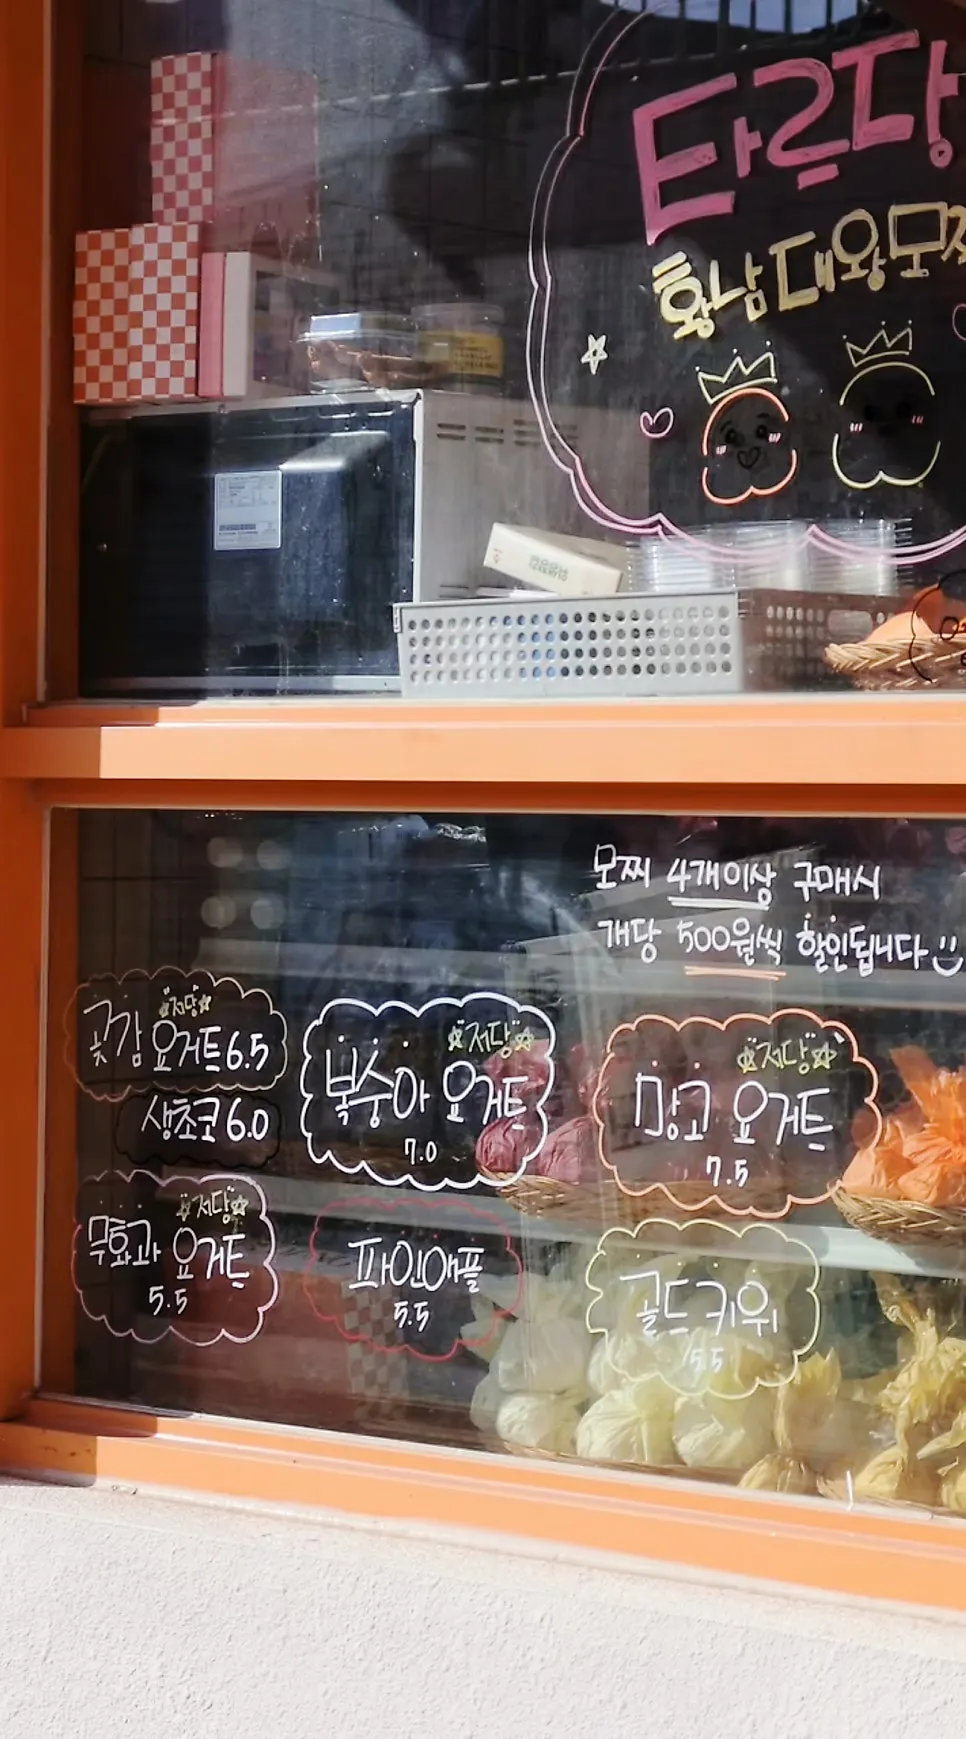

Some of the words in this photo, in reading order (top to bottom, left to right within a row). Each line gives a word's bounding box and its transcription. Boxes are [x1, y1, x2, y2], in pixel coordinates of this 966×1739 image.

[632, 29, 960, 246] 타르당
[593, 843, 652, 891] 모찌
[793, 860, 881, 901] 구매시
[597, 918, 663, 964] 개당
[676, 916, 784, 967] 500원씩
[796, 914, 930, 979] 할인됩니다
[168, 994, 199, 1018] 저당
[151, 1019, 222, 1073] 요거트
[226, 1030, 270, 1072] 6.5
[464, 1019, 515, 1060] 저당
[756, 1037, 812, 1076] 저당
[325, 1046, 432, 1129] 복숭아
[442, 1060, 529, 1132] 요거트
[634, 1072, 712, 1142] 망고
[732, 1080, 835, 1152] 요거트
[141, 1094, 221, 1144] 생초코
[226, 1096, 270, 1143] 6.0
[404, 1137, 438, 1166] 7.0
[705, 1155, 750, 1188] 7.5
[191, 1190, 234, 1225] 저당
[88, 1215, 163, 1268] 무화과
[172, 1226, 251, 1290] 요거트
[347, 1236, 486, 1294] 파인애플
[148, 1284, 190, 1317] 5.5
[393, 1300, 430, 1333] 5.5
